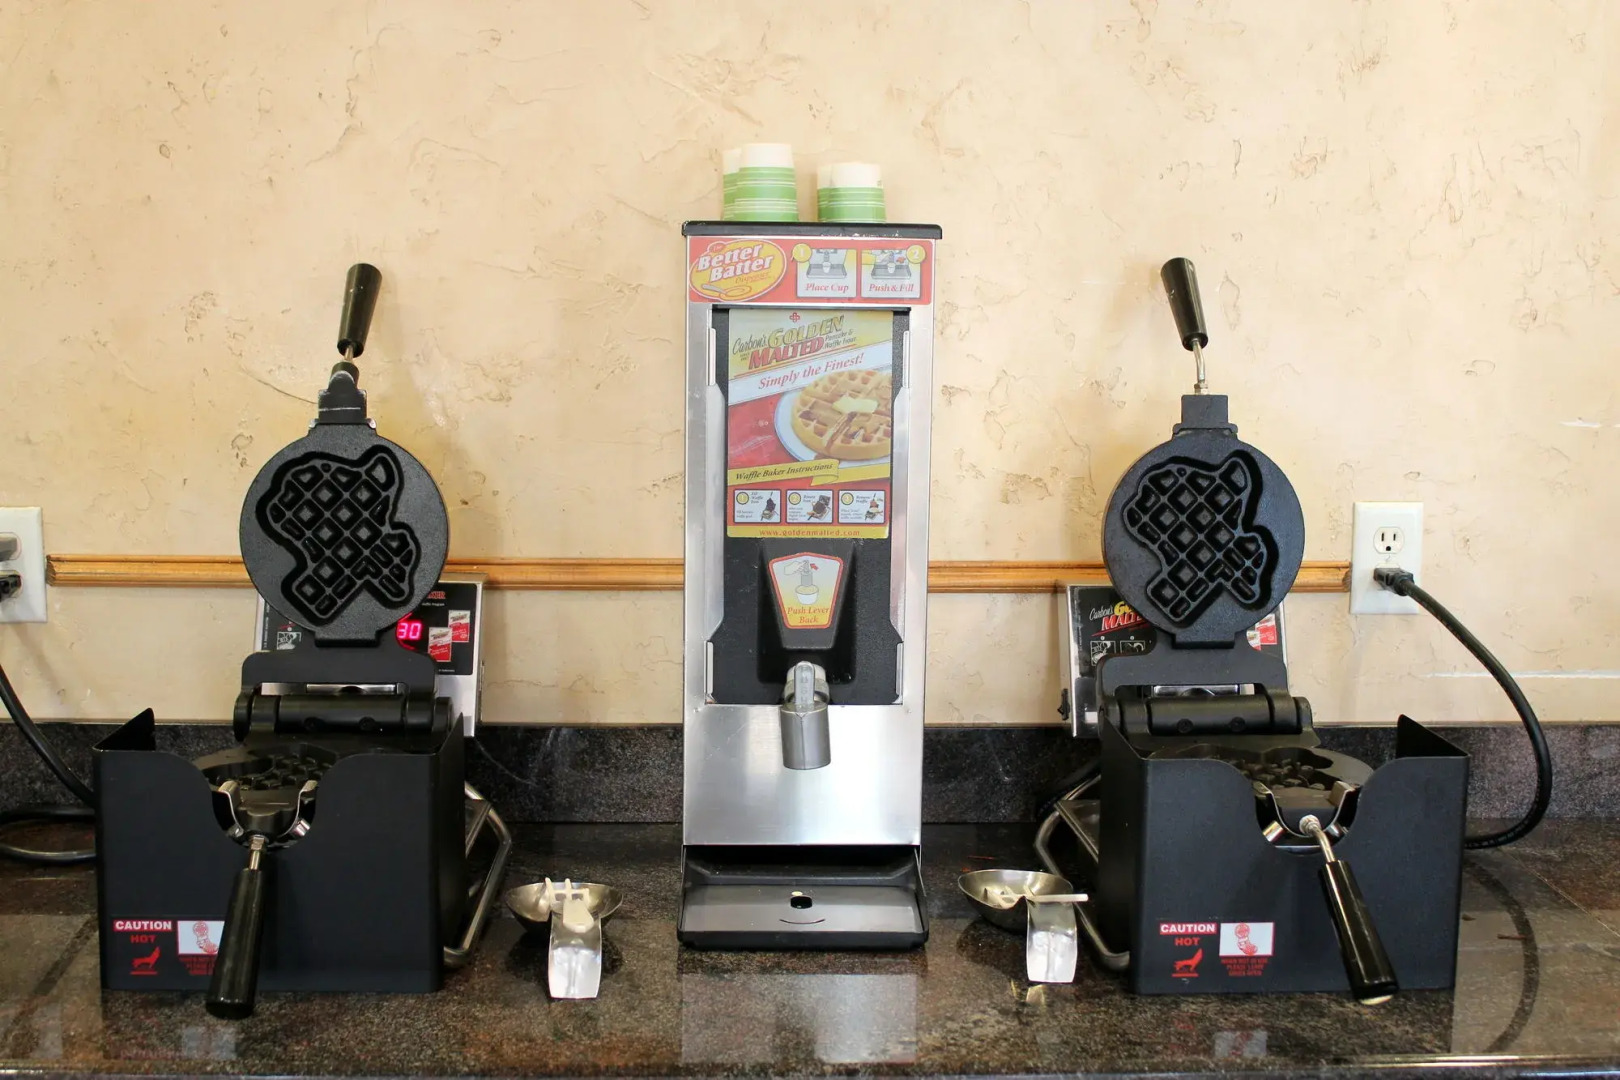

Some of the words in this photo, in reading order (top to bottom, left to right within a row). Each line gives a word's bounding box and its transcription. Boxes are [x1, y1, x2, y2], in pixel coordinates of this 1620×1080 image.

[697, 244, 763, 271] Better
[710, 255, 774, 283] Batter
[805, 283, 829, 292] Place
[831, 283, 850, 293] Cup
[868, 283, 890, 292] Push
[898, 283, 914, 292] Fill
[767, 314, 845, 349] GOLDEN
[748, 336, 824, 370] MALTED
[758, 371, 799, 390] Simply
[802, 365, 822, 379] the
[824, 352, 865, 373] Finest!
[735, 470, 760, 481] Waffle
[762, 468, 785, 478] Baker
[786, 462, 834, 475] Instructions
[759, 529, 860, 537] www.goldenmalted.com
[787, 606, 806, 615] Push
[808, 606, 830, 614] Lever
[798, 616, 819, 624] Back
[398, 622, 422, 639] 30
[115, 921, 172, 930] CAUTION
[1160, 923, 1216, 933] CAUTION
[130, 934, 156, 944] HOT
[1175, 937, 1200, 946] HOT
